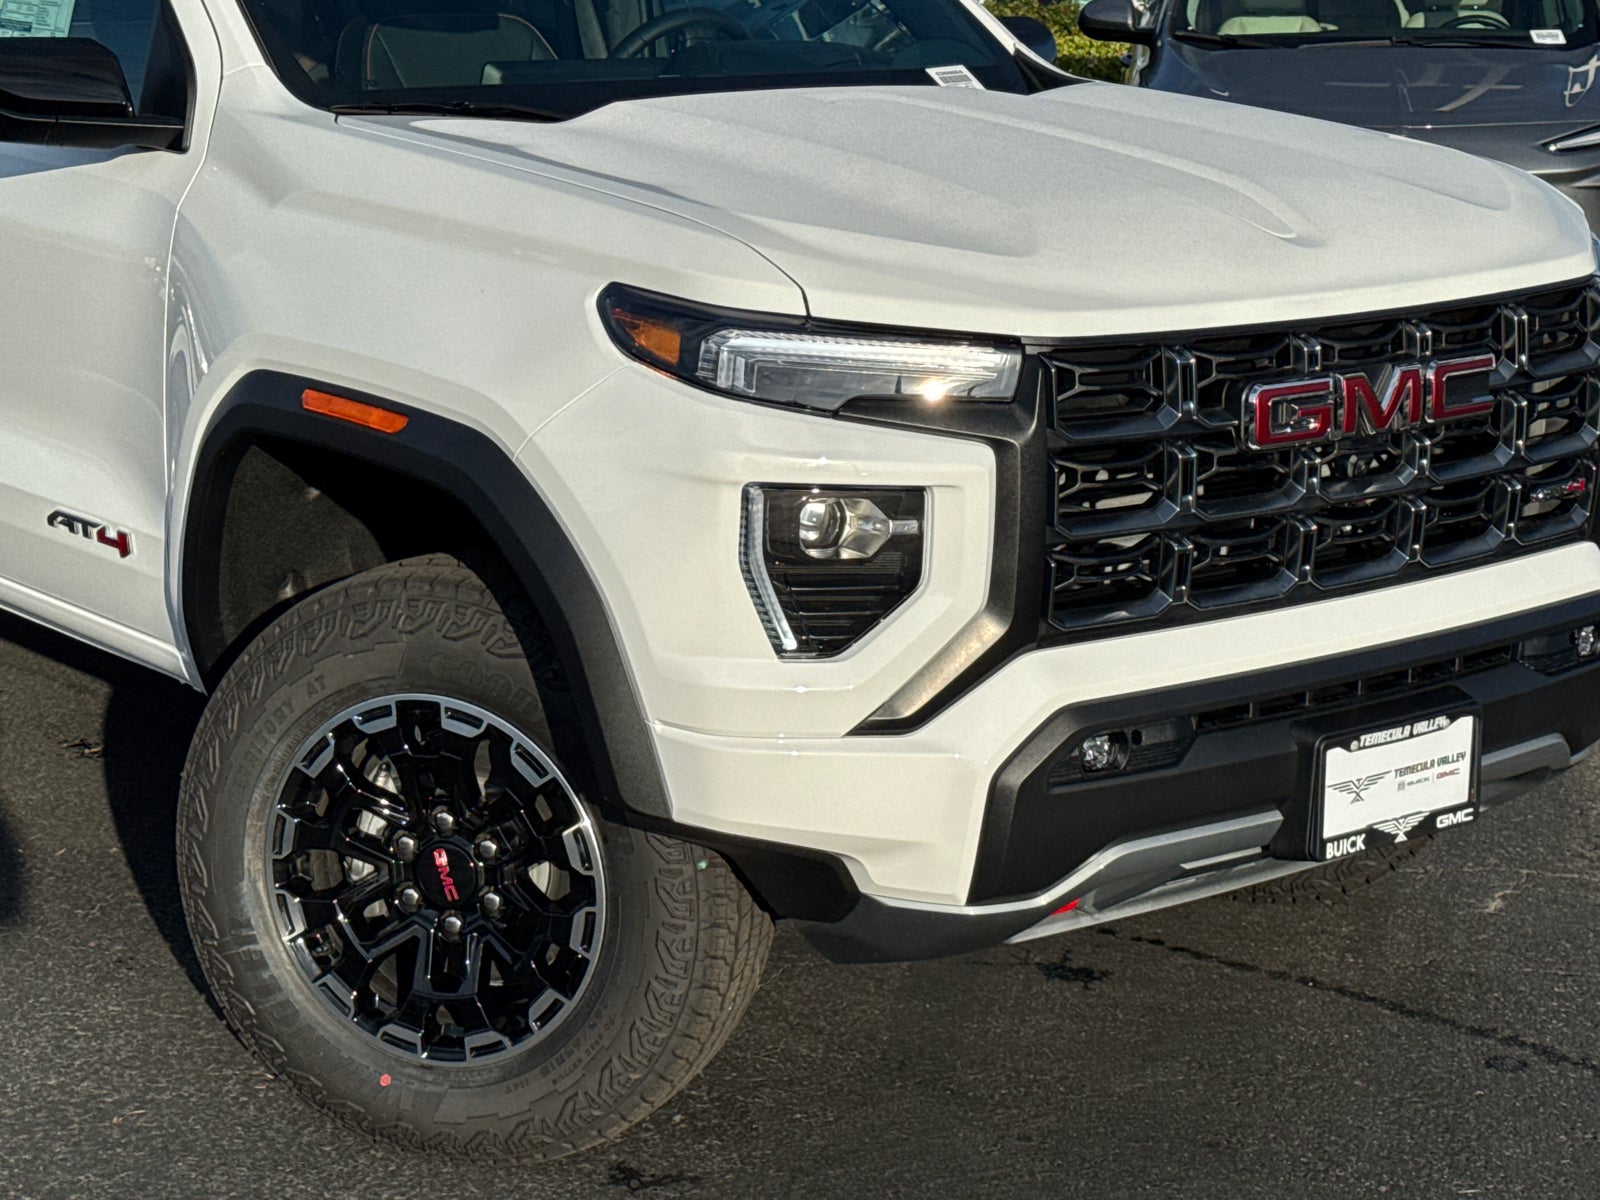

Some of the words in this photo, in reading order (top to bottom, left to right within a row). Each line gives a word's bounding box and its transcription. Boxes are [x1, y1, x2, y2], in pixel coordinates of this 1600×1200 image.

[1247, 353, 1497, 450] GMC
[47, 509, 132, 559] AT4
[1360, 724, 1411, 748] TEMECULA
[1394, 759, 1435, 779] TEMECULA
[1436, 751, 1466, 767] VALLEY
[1406, 776, 1430, 787] BUICK
[1436, 768, 1460, 779] GMC
[1436, 808, 1474, 829] GMC
[1325, 833, 1366, 860] BUICK
[434, 848, 460, 901] GMC
